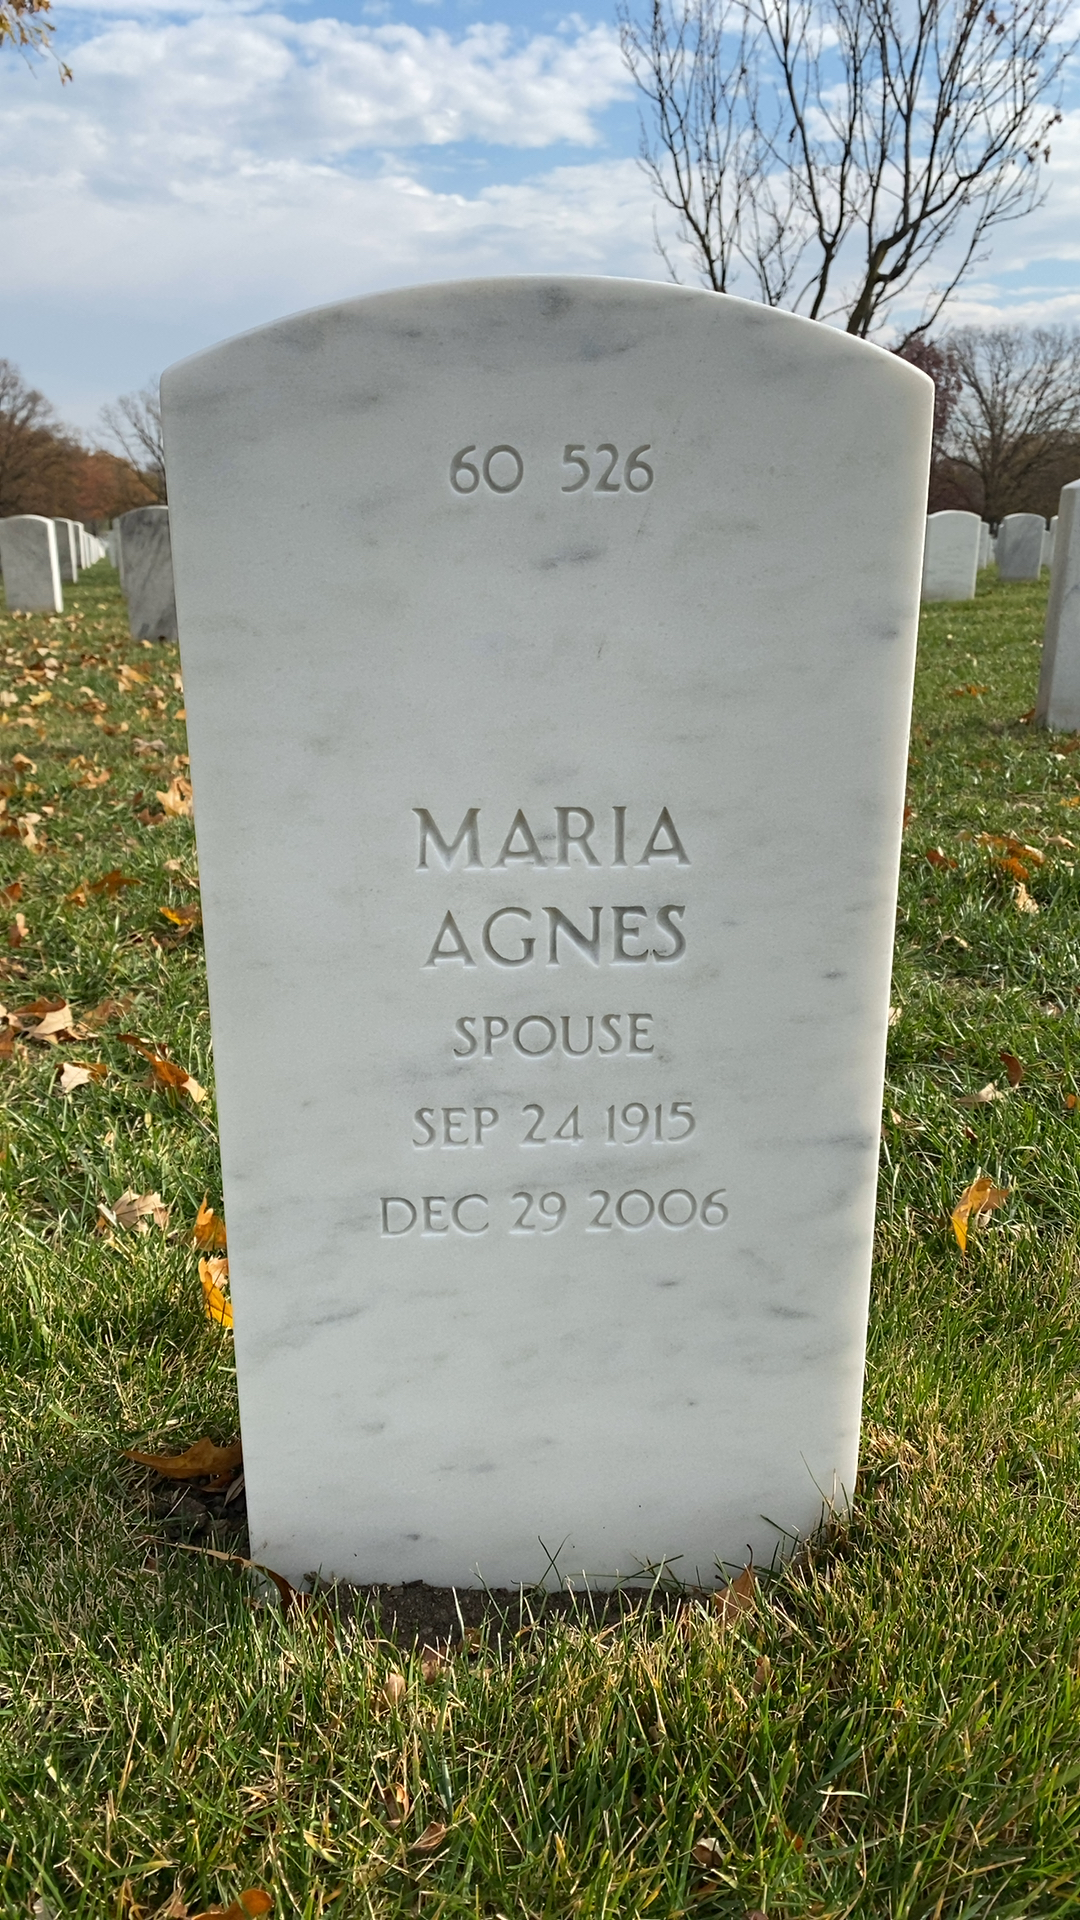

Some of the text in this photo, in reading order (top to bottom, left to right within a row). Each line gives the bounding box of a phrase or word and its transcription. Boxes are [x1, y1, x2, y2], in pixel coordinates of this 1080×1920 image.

[449, 443, 654, 494] 60 526
[412, 806, 692, 871] MARIA
[420, 904, 687, 969] AGNES
[453, 1013, 655, 1059] SPOUSE
[412, 1101, 696, 1149] SEP 24 1915
[380, 1188, 729, 1238] DEC 29 2006
